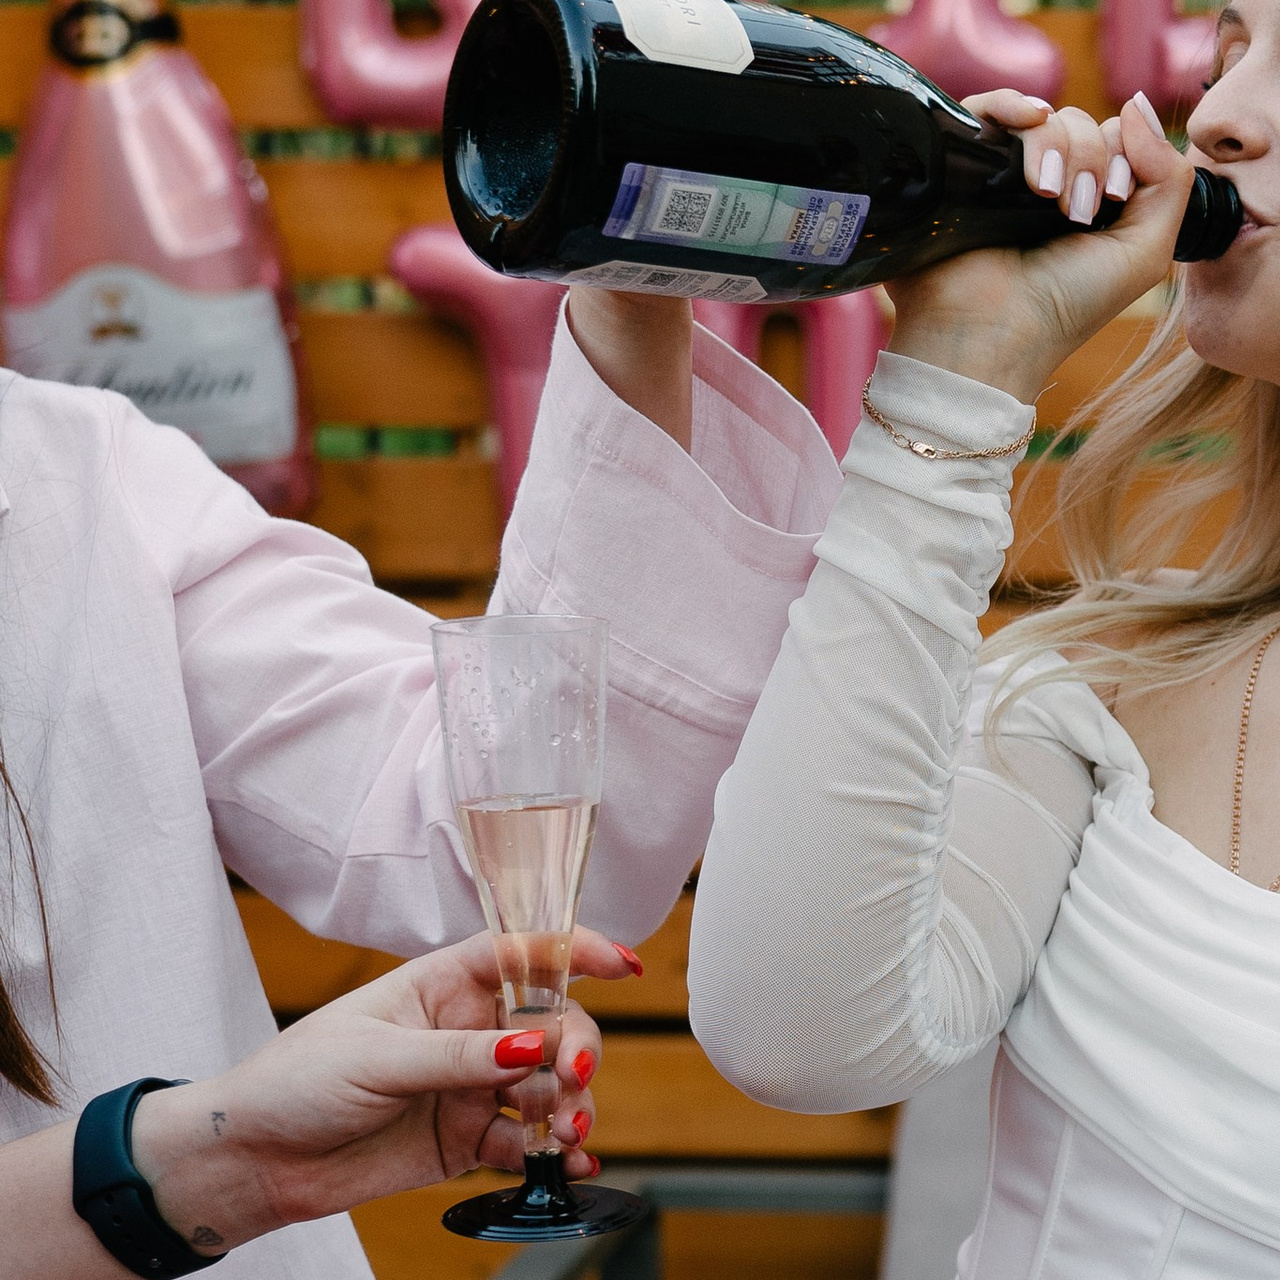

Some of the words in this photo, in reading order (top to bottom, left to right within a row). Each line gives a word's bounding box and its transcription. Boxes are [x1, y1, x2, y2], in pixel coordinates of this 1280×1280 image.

[789, 211, 806, 240] МАРКА
[789, 197, 817, 255] СПЕЦИАЛЬНАЯ
[797, 198, 823, 256] ФЕДЕРАЛЬНАЯ
[828, 203, 853, 257] ФЕДЕРАЦИЯ
[835, 203, 860, 257] РОССИЙСКАЯ
